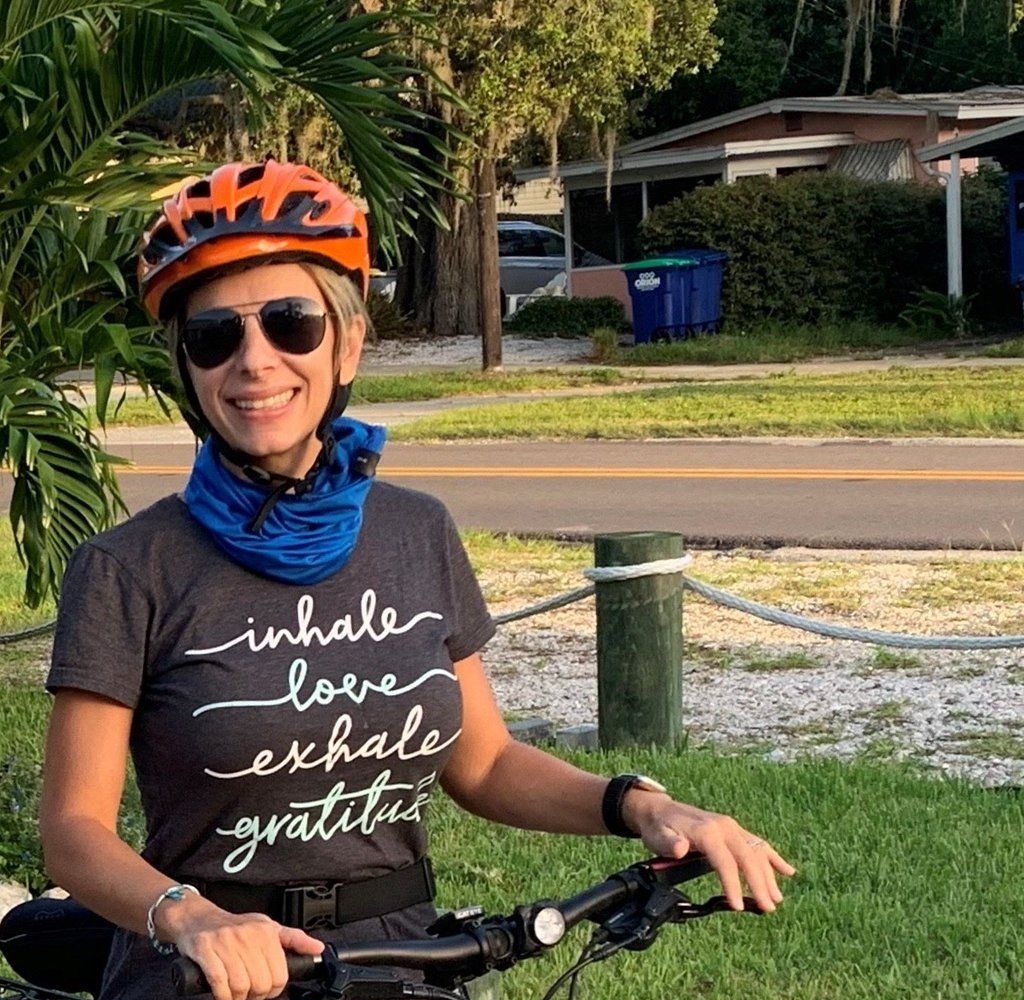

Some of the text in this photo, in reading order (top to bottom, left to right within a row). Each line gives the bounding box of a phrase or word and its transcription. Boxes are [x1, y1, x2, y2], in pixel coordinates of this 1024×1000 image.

[184, 588, 444, 655] inhale
[192, 658, 459, 717] love
[203, 704, 463, 779] exhale
